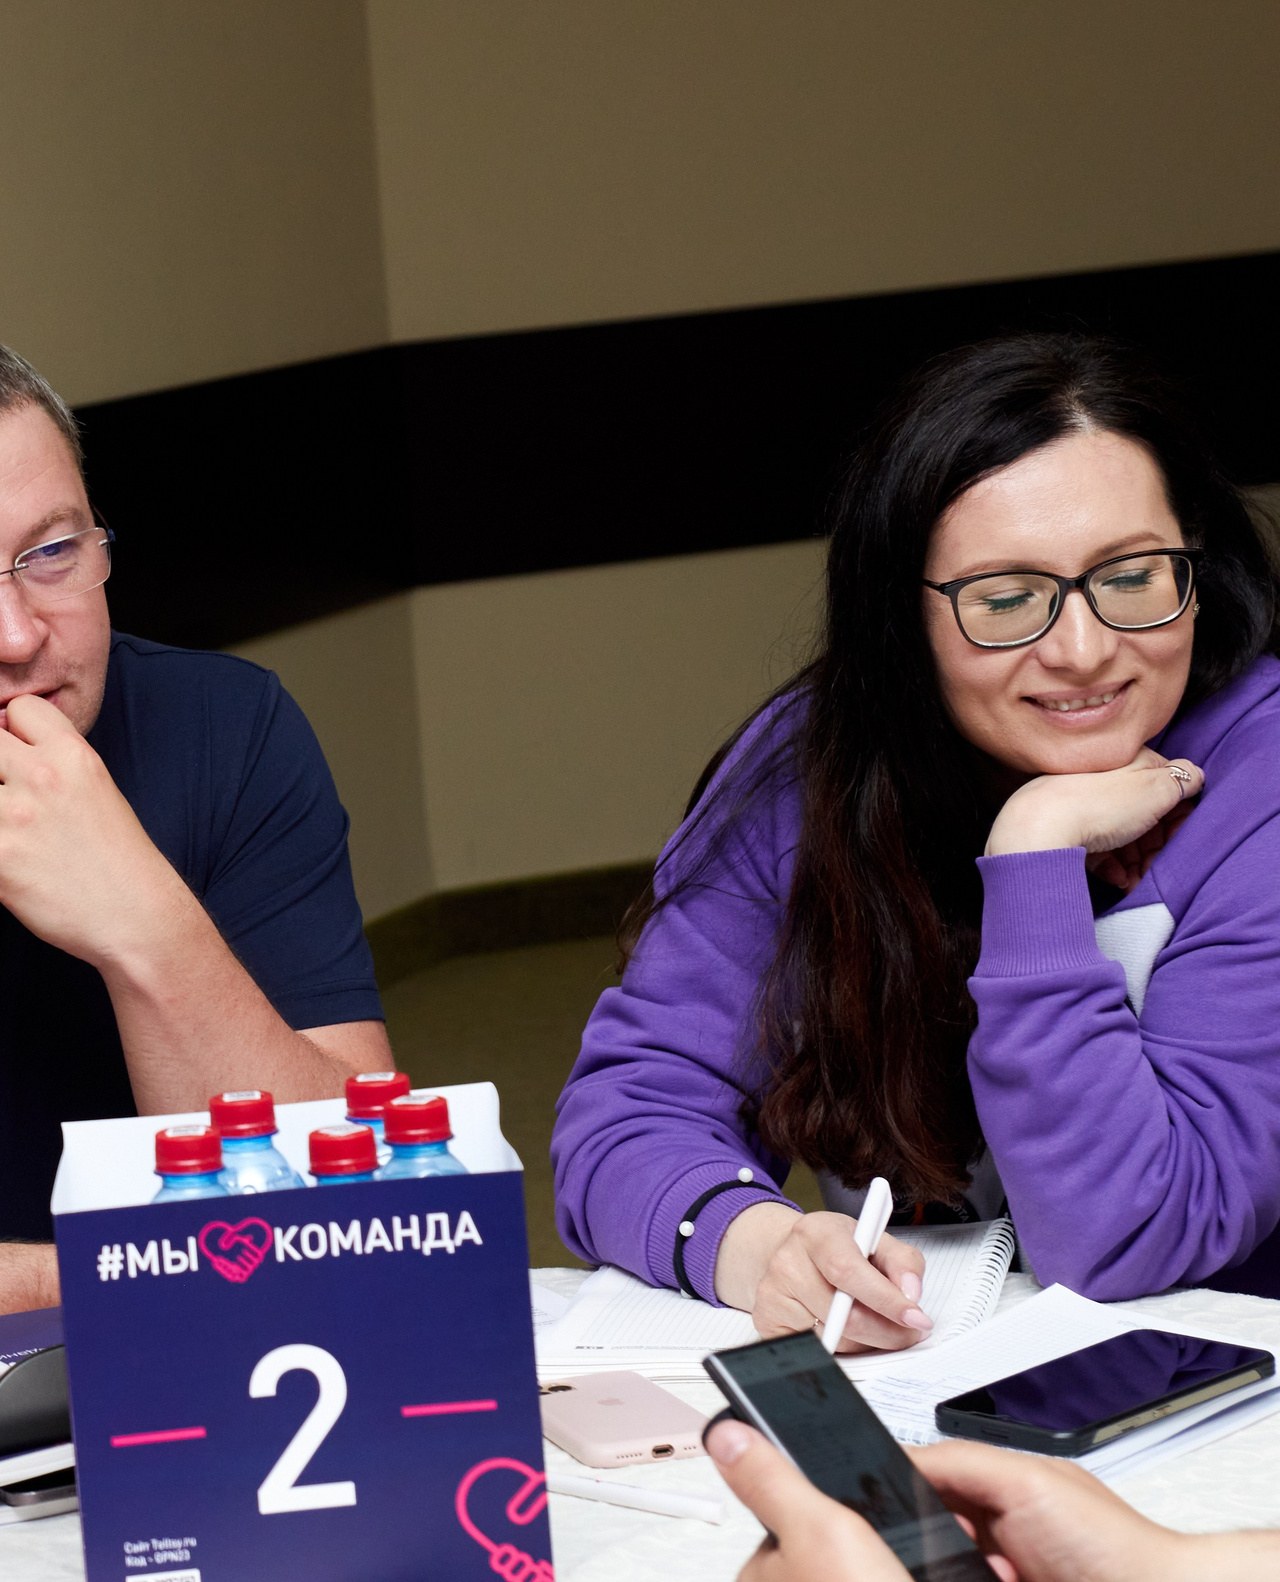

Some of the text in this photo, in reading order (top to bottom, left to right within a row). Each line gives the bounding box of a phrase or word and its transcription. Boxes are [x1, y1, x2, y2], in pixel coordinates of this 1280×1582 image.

[96, 1210, 483, 1282] #МЫ КОМАНДА
[248, 1343, 357, 1516] 2
[125, 1555, 148, 1567] Код
